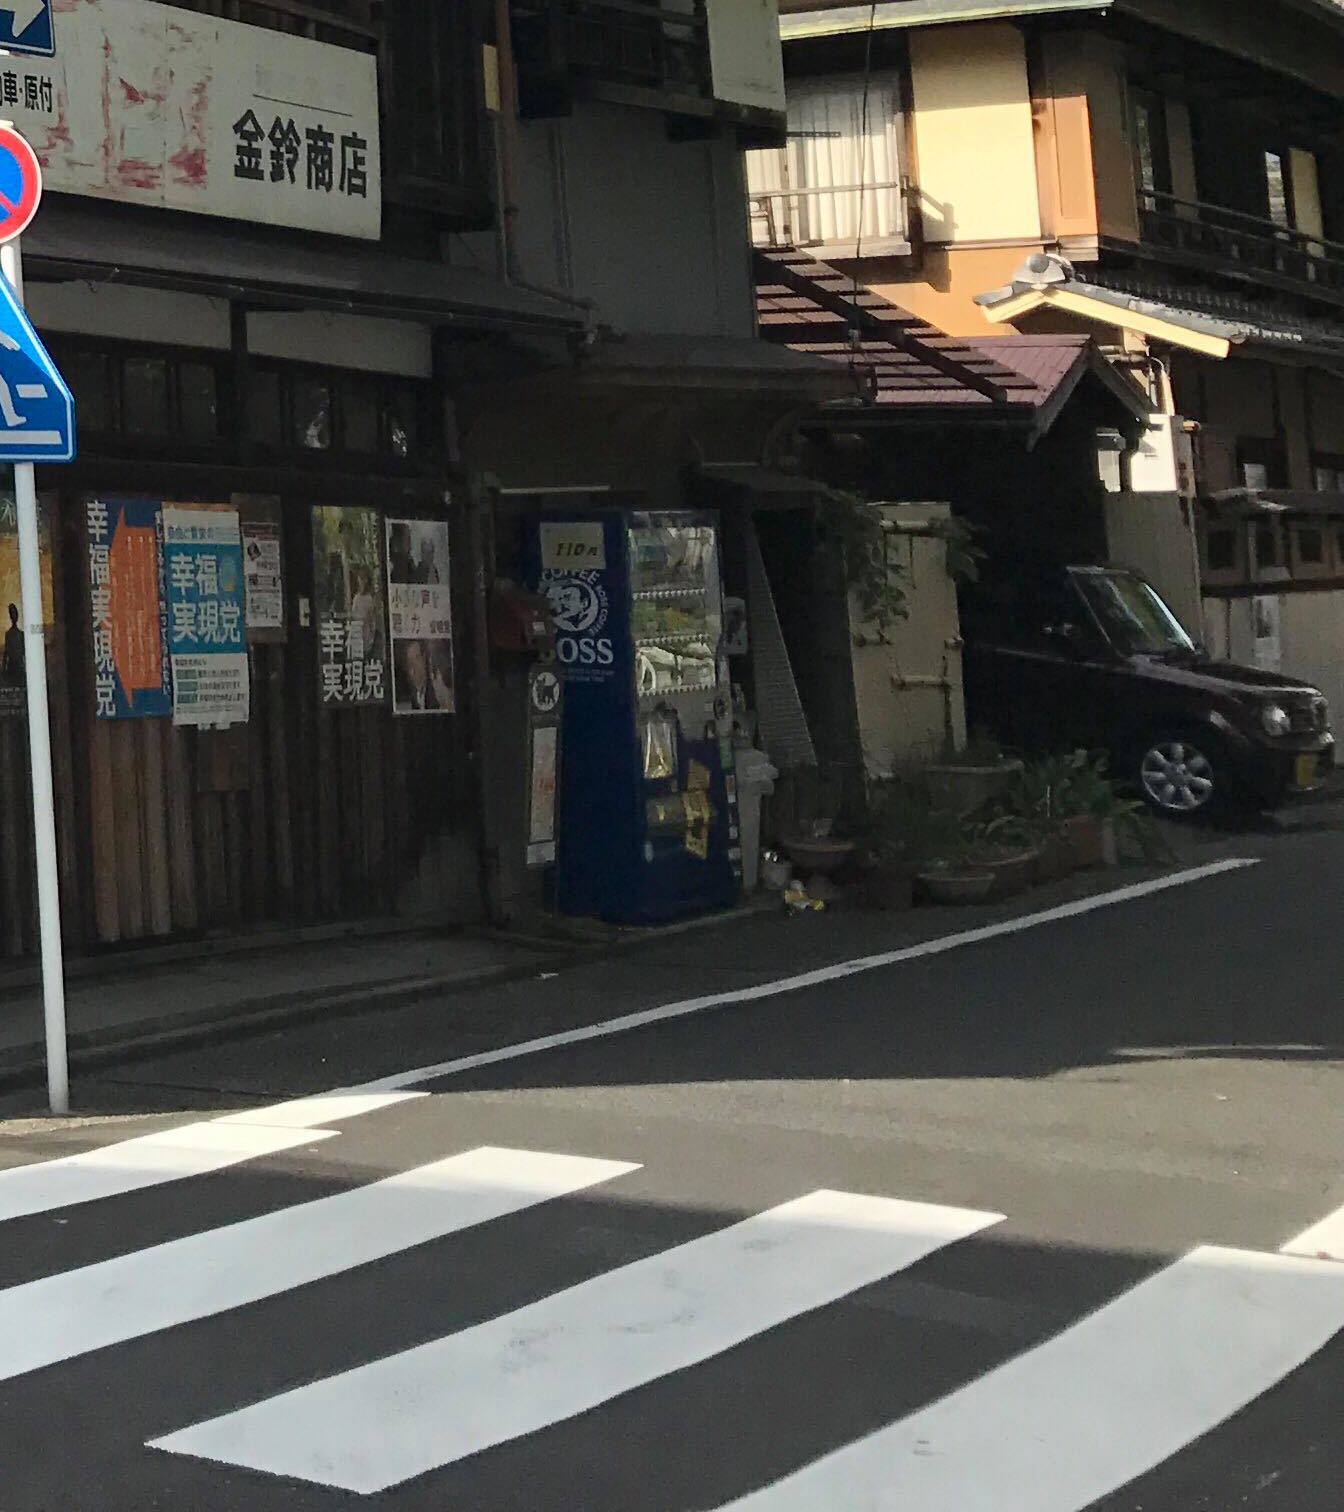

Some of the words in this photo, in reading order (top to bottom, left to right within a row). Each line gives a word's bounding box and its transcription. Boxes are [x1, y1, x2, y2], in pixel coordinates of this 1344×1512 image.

[232, 109, 367, 198] 金鈴商店
[170, 552, 219, 597] 幸福
[86, 500, 116, 717] 幸福実現党
[172, 599, 242, 645] 実現党
[320, 618, 365, 665] 幸福
[322, 657, 385, 703] 実現党
